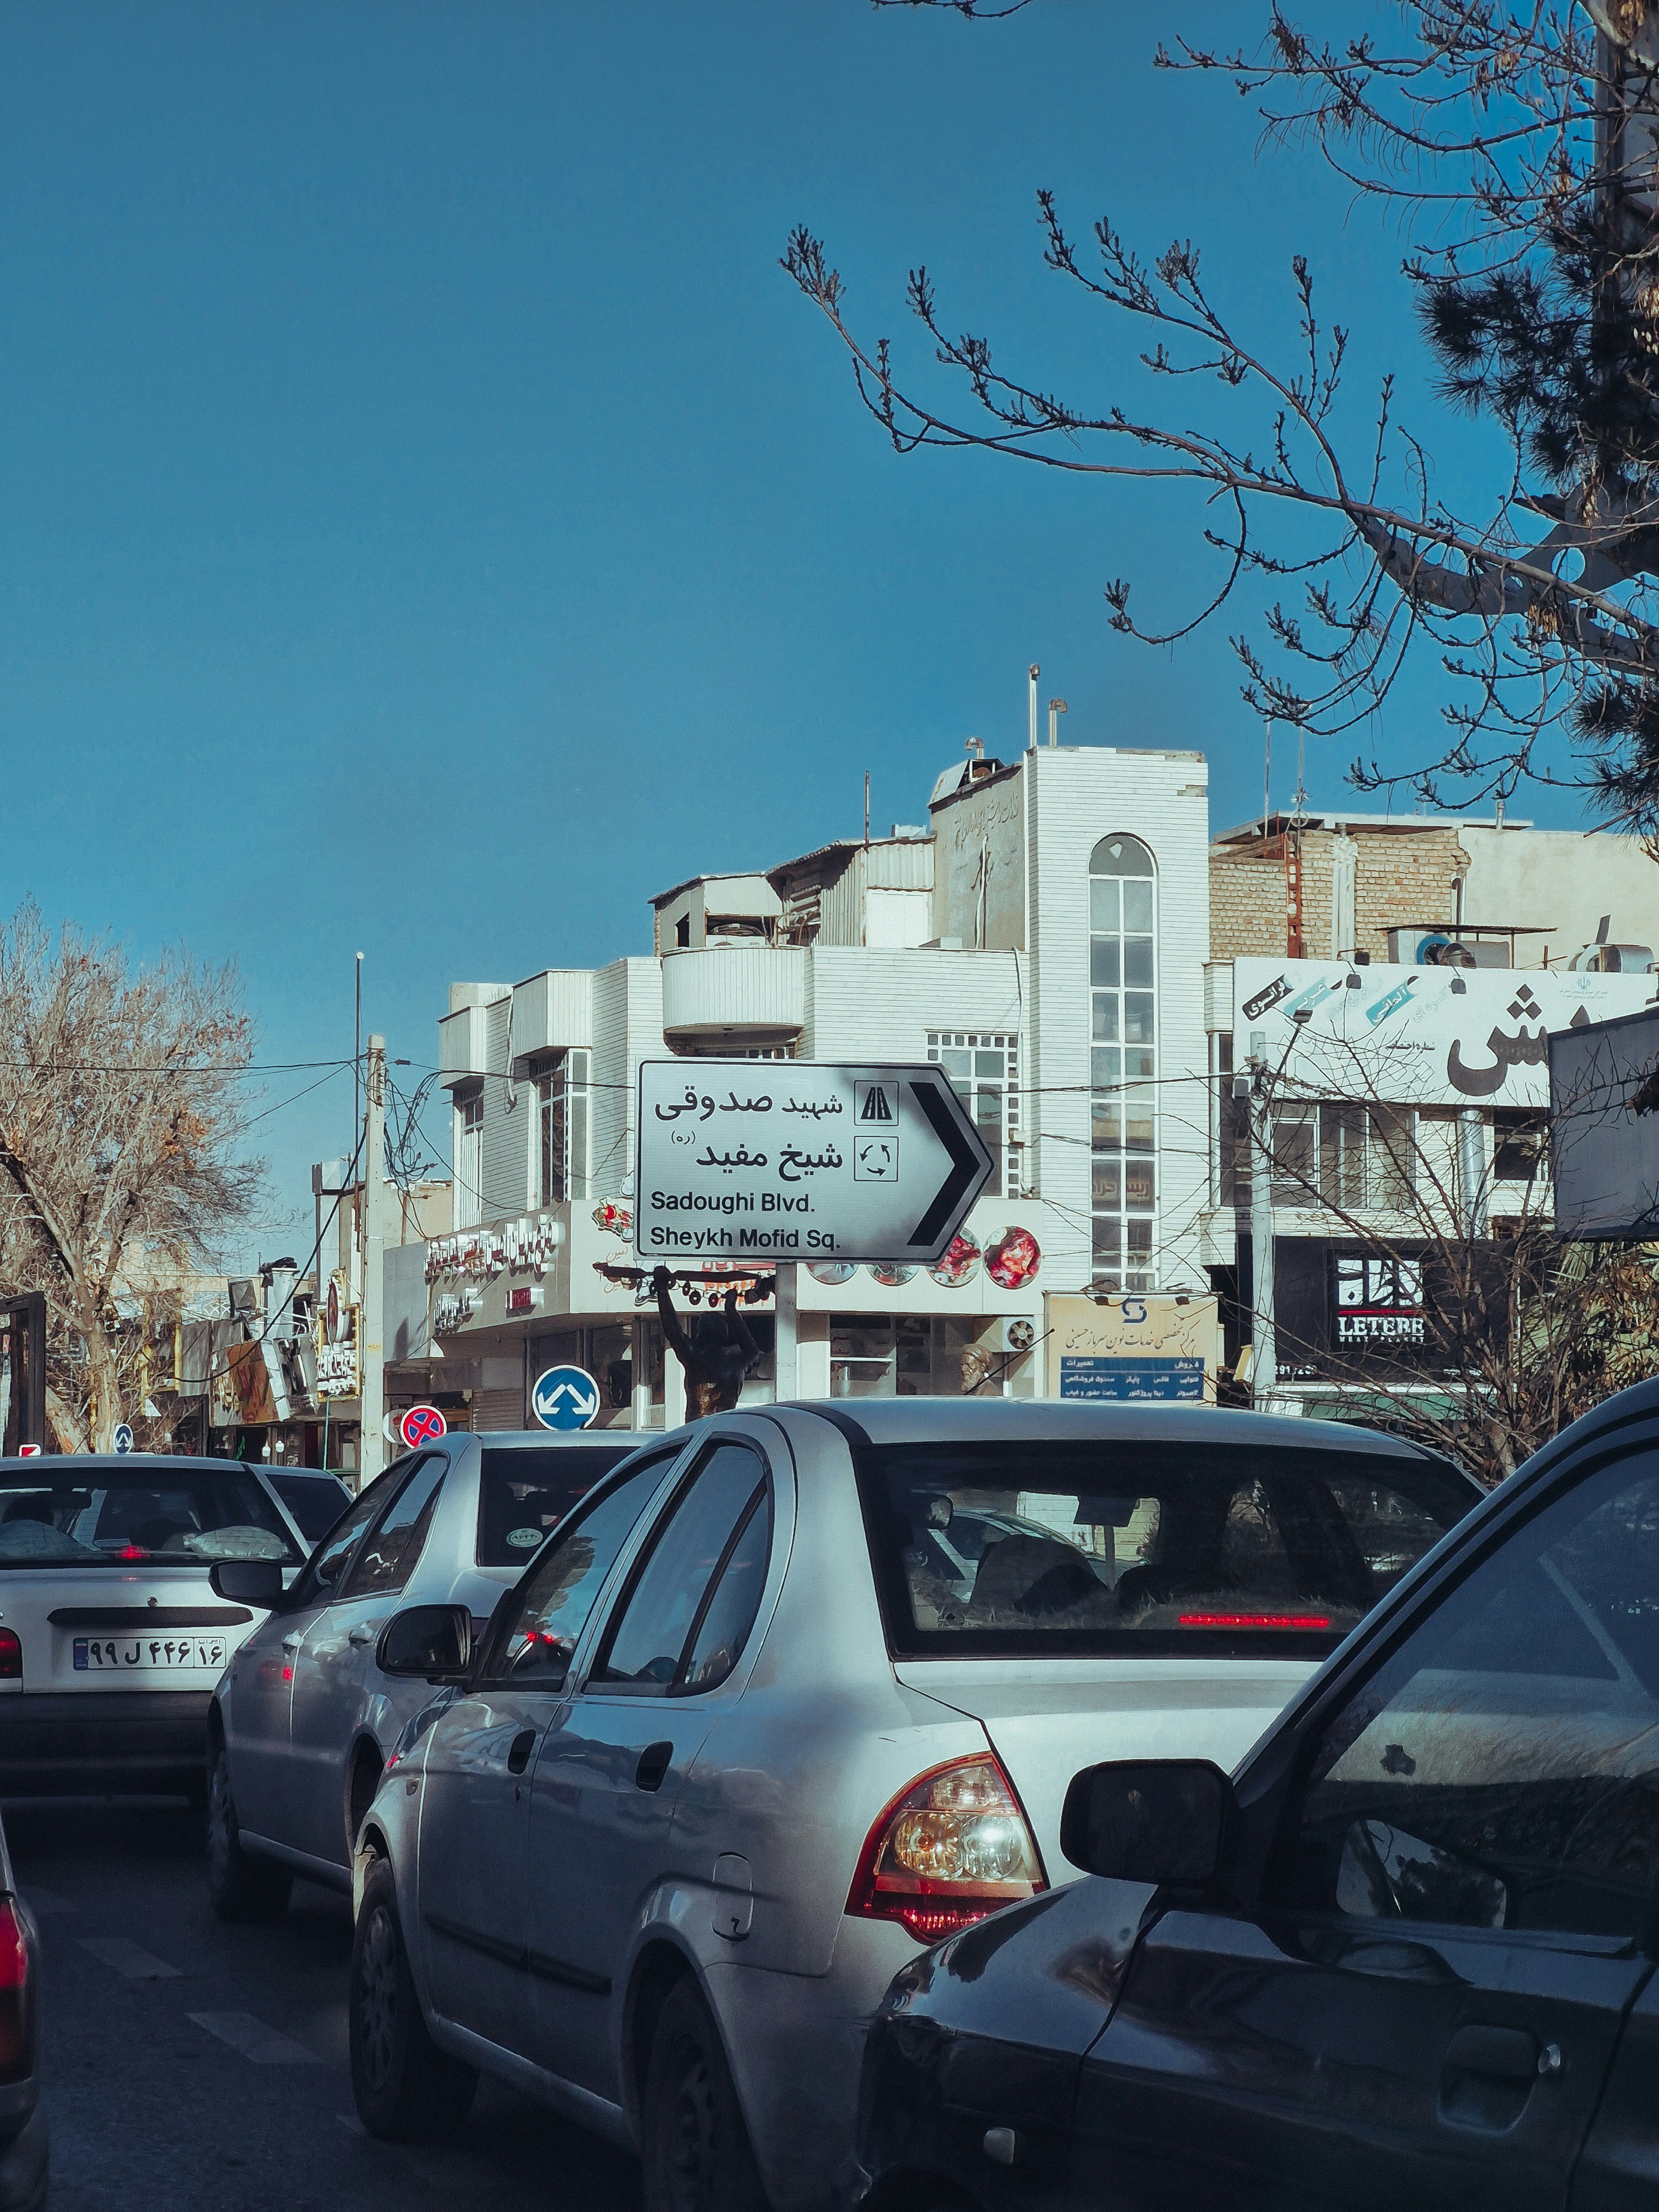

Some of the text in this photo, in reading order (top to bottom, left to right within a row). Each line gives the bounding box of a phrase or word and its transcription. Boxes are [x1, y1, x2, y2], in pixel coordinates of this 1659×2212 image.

[655, 1086, 842, 1121] شهید صدوقی
[696, 1144, 767, 1173] مفید
[779, 1144, 842, 1181] شیخ
[651, 1191, 815, 1214] Sadoughi Blvd.
[650, 1227, 841, 1251] Sheykh Mofid Sq.
[1106, 1328, 1125, 1354] نوین
[1125, 1331, 1154, 1346] خدمات
[1154, 1323, 1184, 1350] تخصصی
[1181, 1319, 1201, 1350] مرکز
